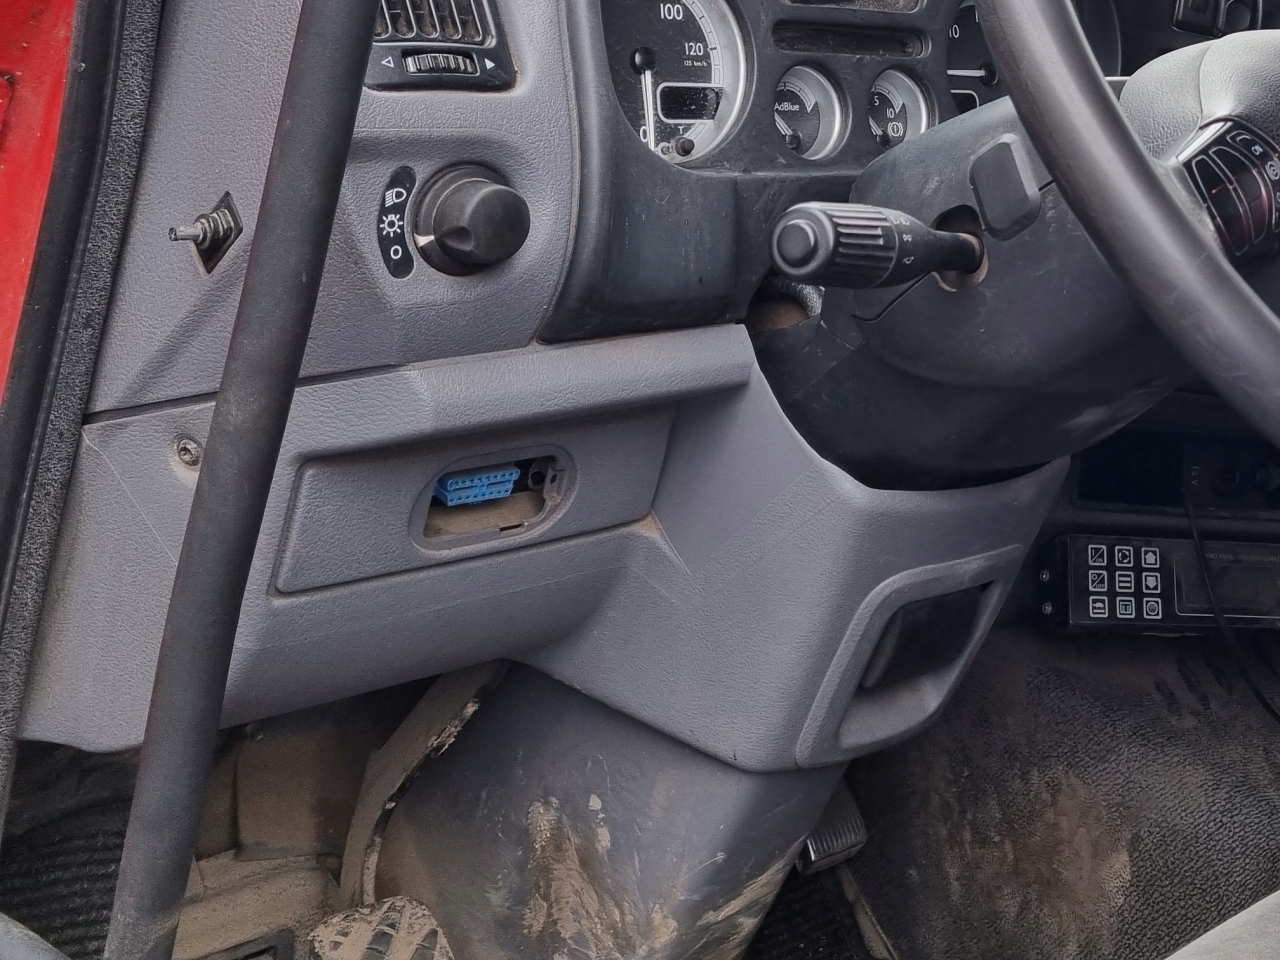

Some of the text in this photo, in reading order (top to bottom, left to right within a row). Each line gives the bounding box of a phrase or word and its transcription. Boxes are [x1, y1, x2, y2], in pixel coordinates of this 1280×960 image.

[660, 3, 684, 20] 100
[685, 42, 704, 56] 120
[874, 95, 879, 106] 5
[773, 101, 800, 112] AdBlue
[886, 108, 895, 119] 10
